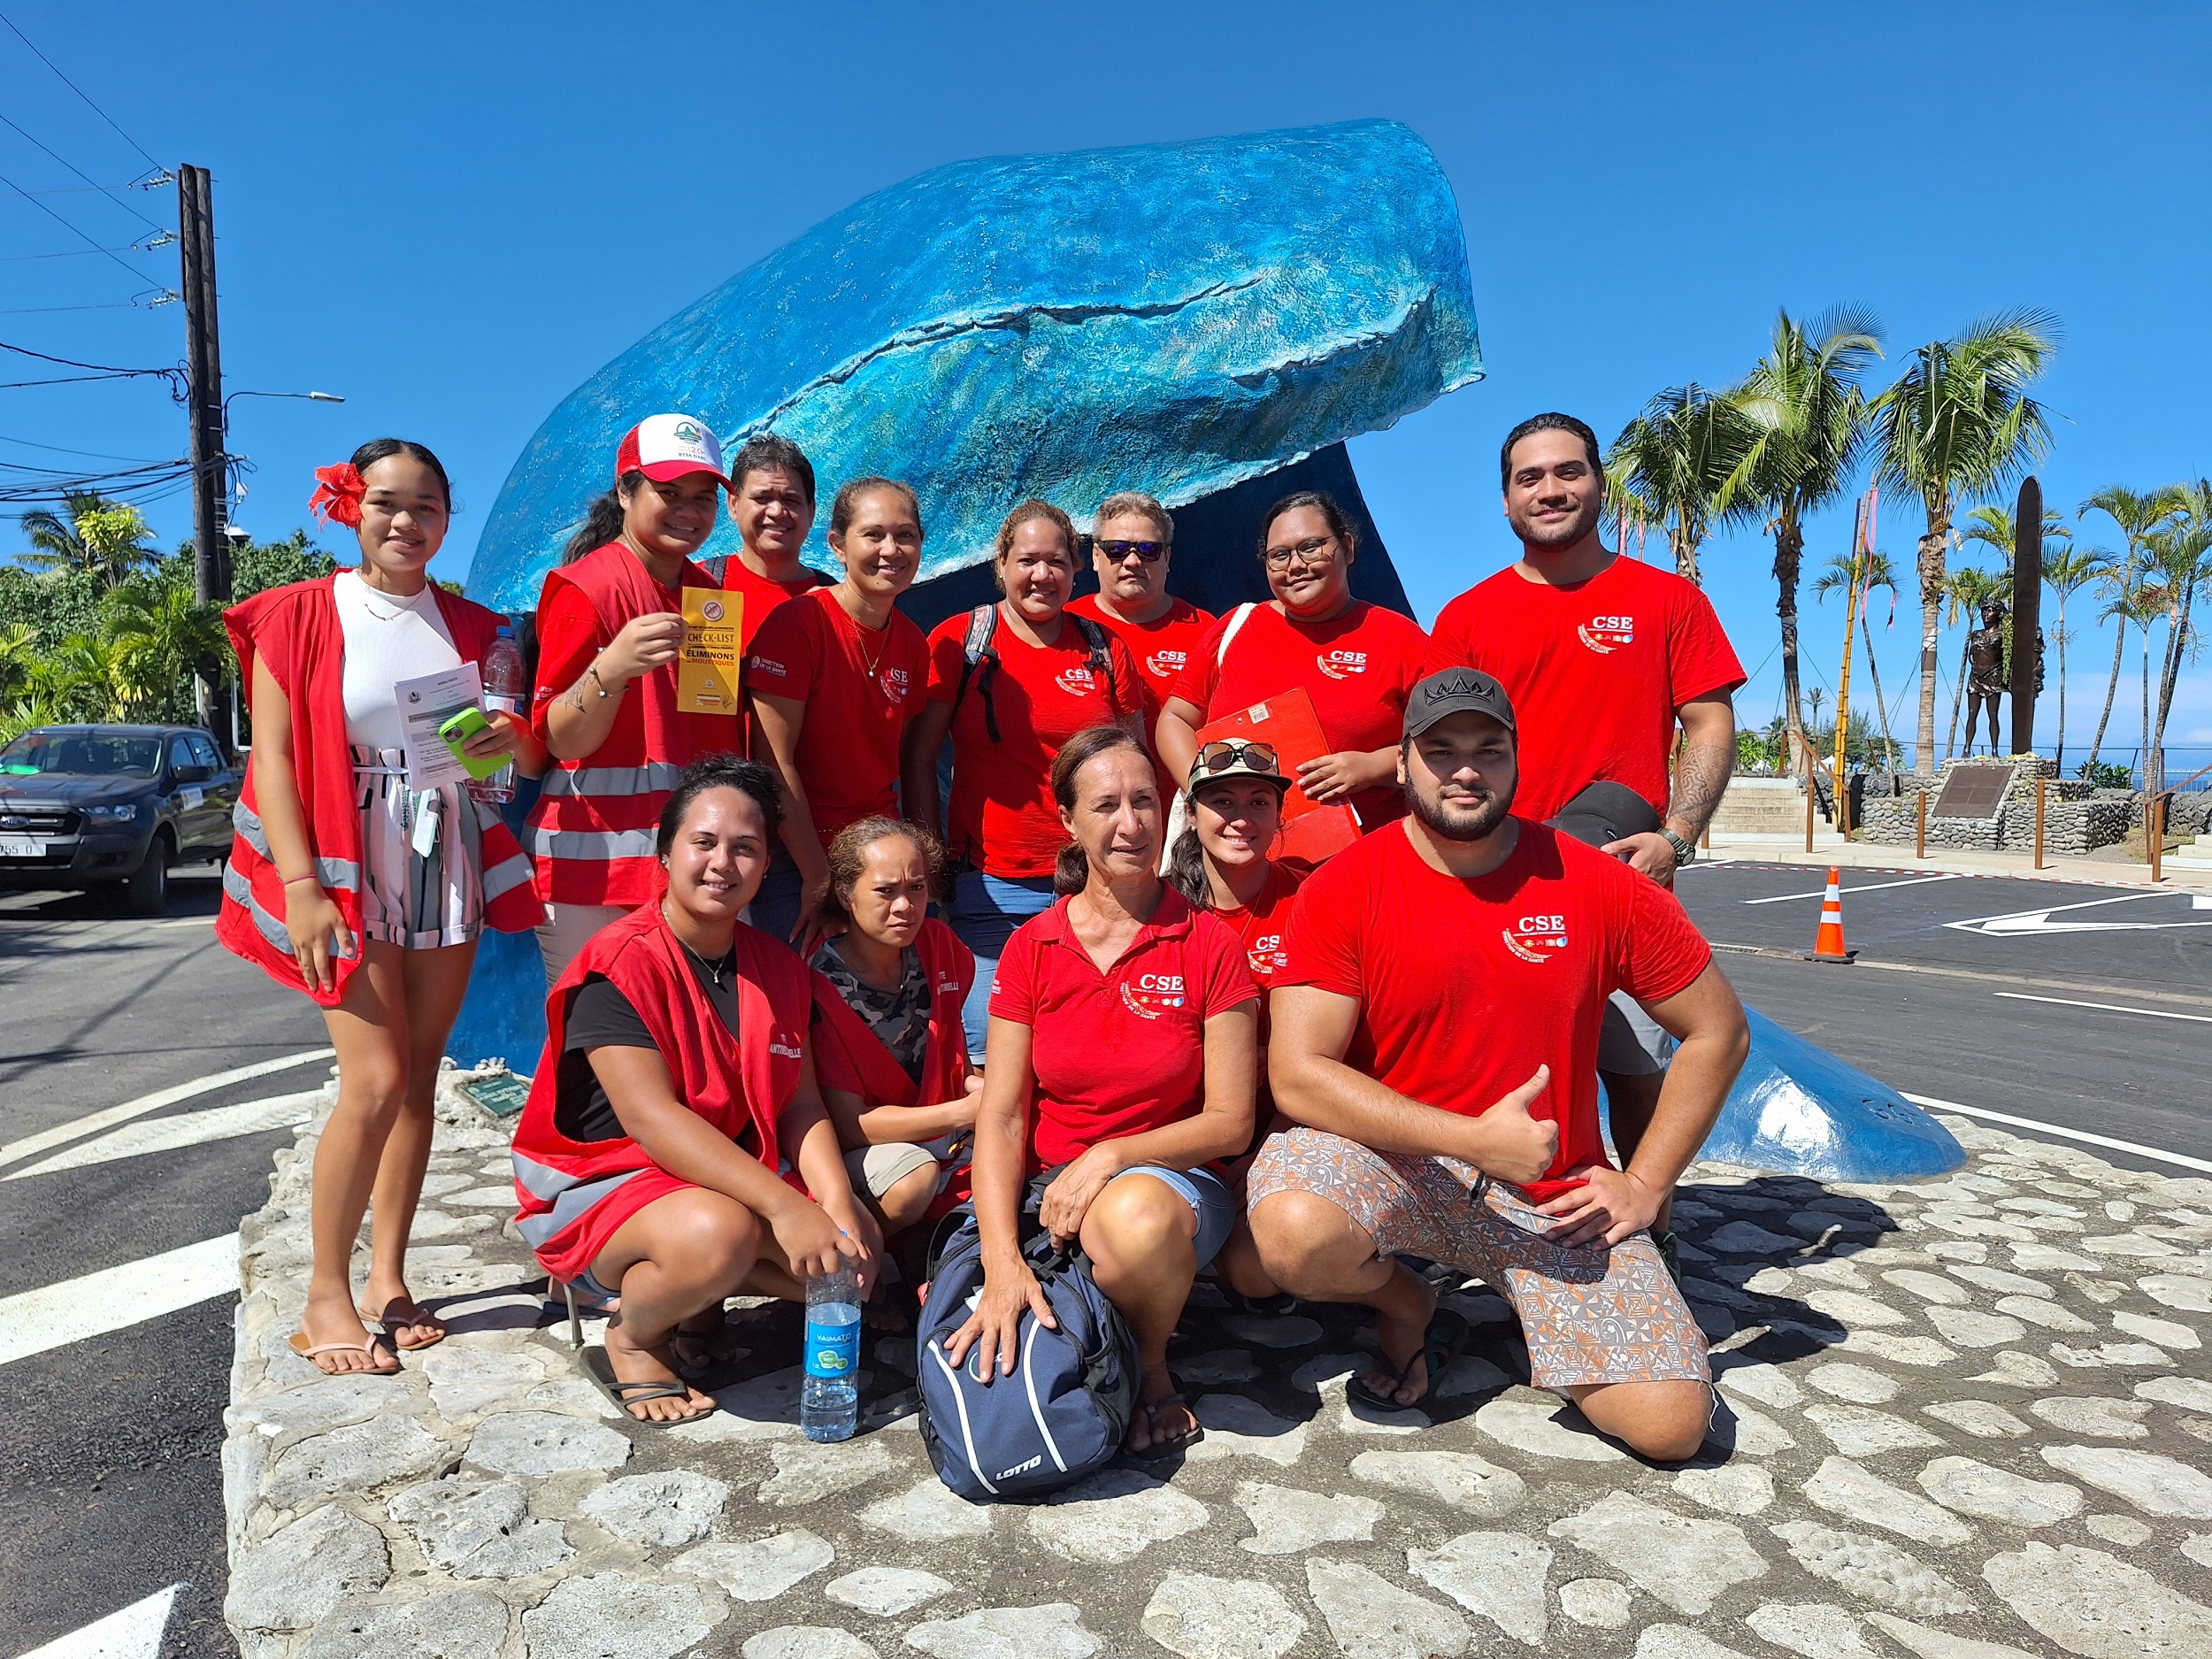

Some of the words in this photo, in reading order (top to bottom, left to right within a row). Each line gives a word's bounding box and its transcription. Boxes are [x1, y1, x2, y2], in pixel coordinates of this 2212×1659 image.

[1593, 616, 1633, 629] CSE
[687, 633, 734, 643] CHECK-LIST
[687, 649, 734, 660] ÉLIMINONS
[1157, 650, 1187, 662] CSE
[1330, 650, 1367, 663] CSE
[761, 657, 785, 669] DIRECTION
[1065, 669, 1093, 680] CSE
[1518, 915, 1565, 932] CSE
[1256, 935, 1280, 950] CS
[1140, 974, 1184, 991] CSE
[817, 1333, 851, 1342] VAIMATO
[995, 1455, 1041, 1481] LOTTO
